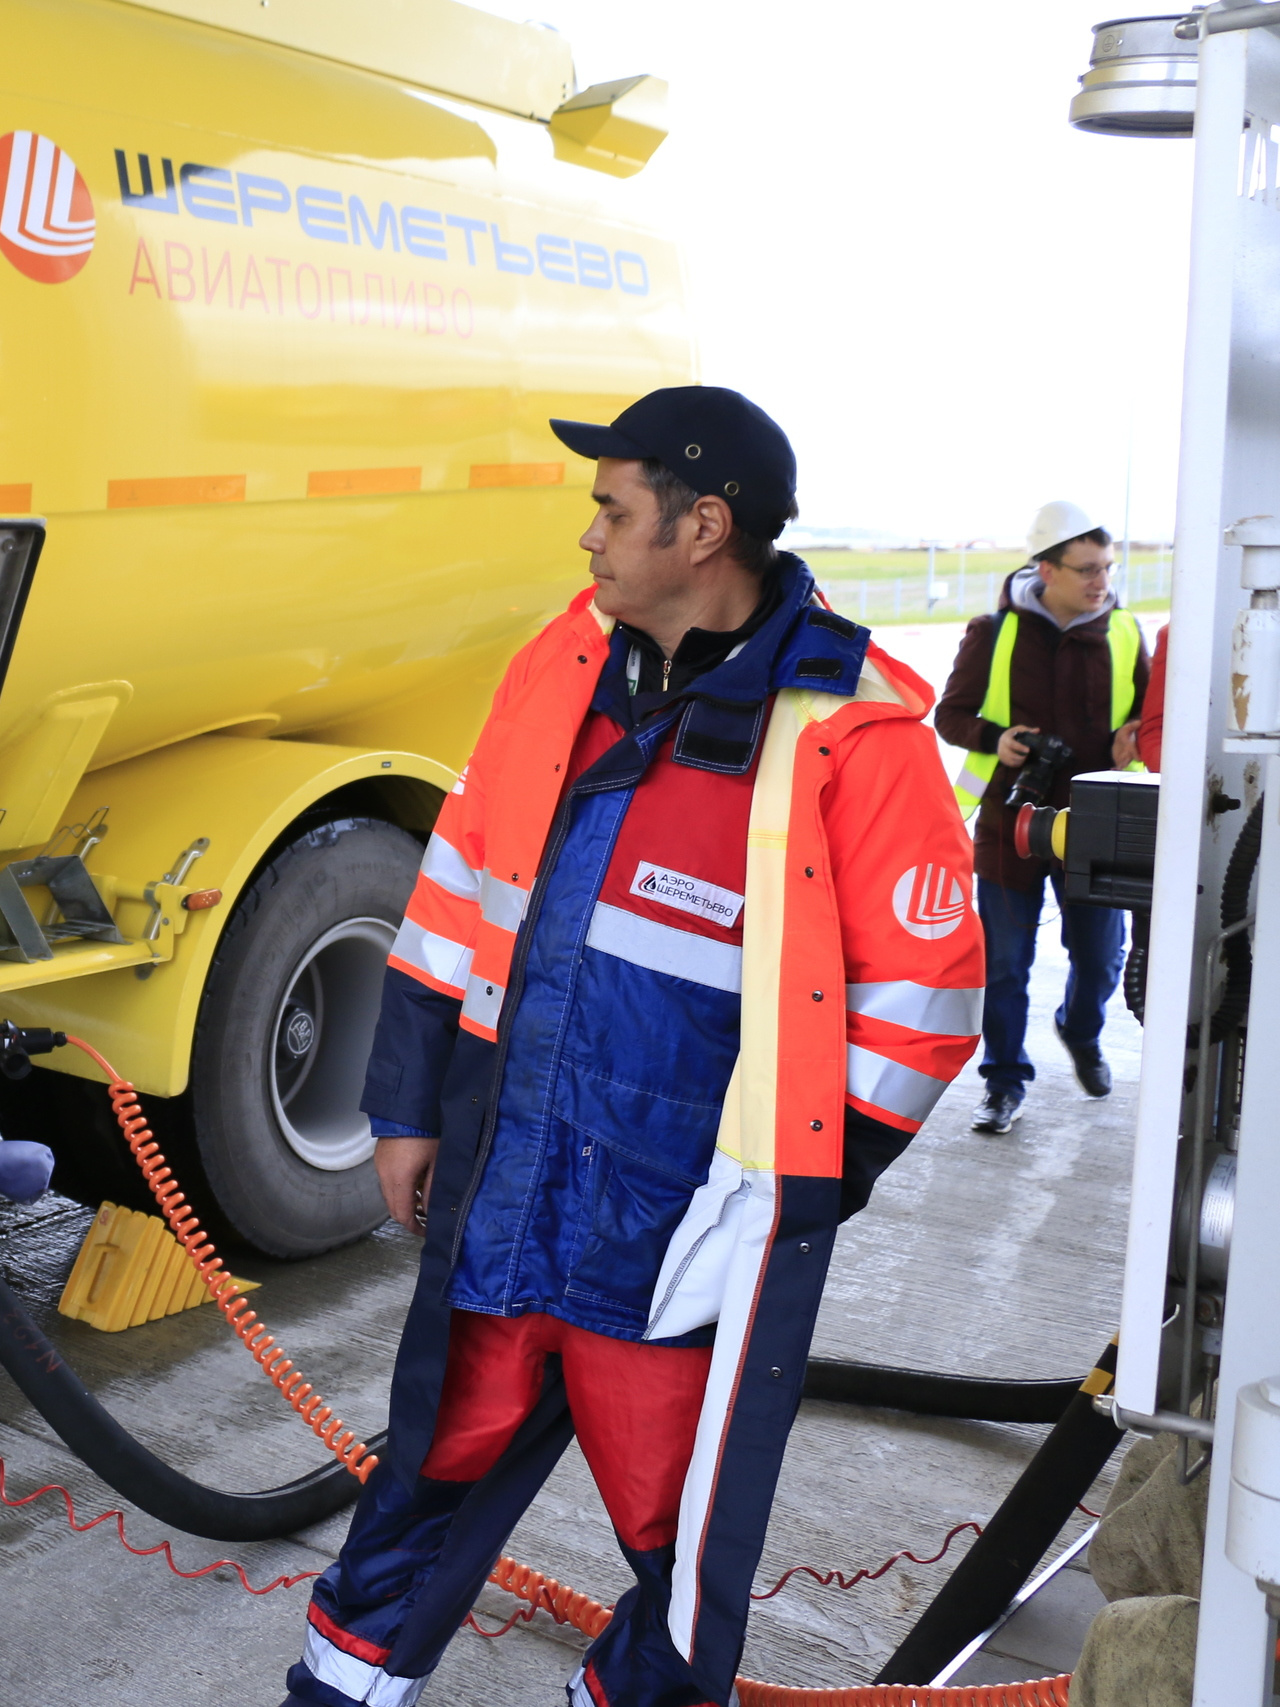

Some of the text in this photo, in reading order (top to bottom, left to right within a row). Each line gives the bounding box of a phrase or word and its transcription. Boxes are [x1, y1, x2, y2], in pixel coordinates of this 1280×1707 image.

[113, 147, 650, 297] ШЕРЕМЕТЬЕВО
[128, 235, 476, 340] АВИАТОПЛИВО
[656, 884, 734, 917] ШЕРЕМЕТЬЕВО
[660, 873, 695, 891] АЭРО
